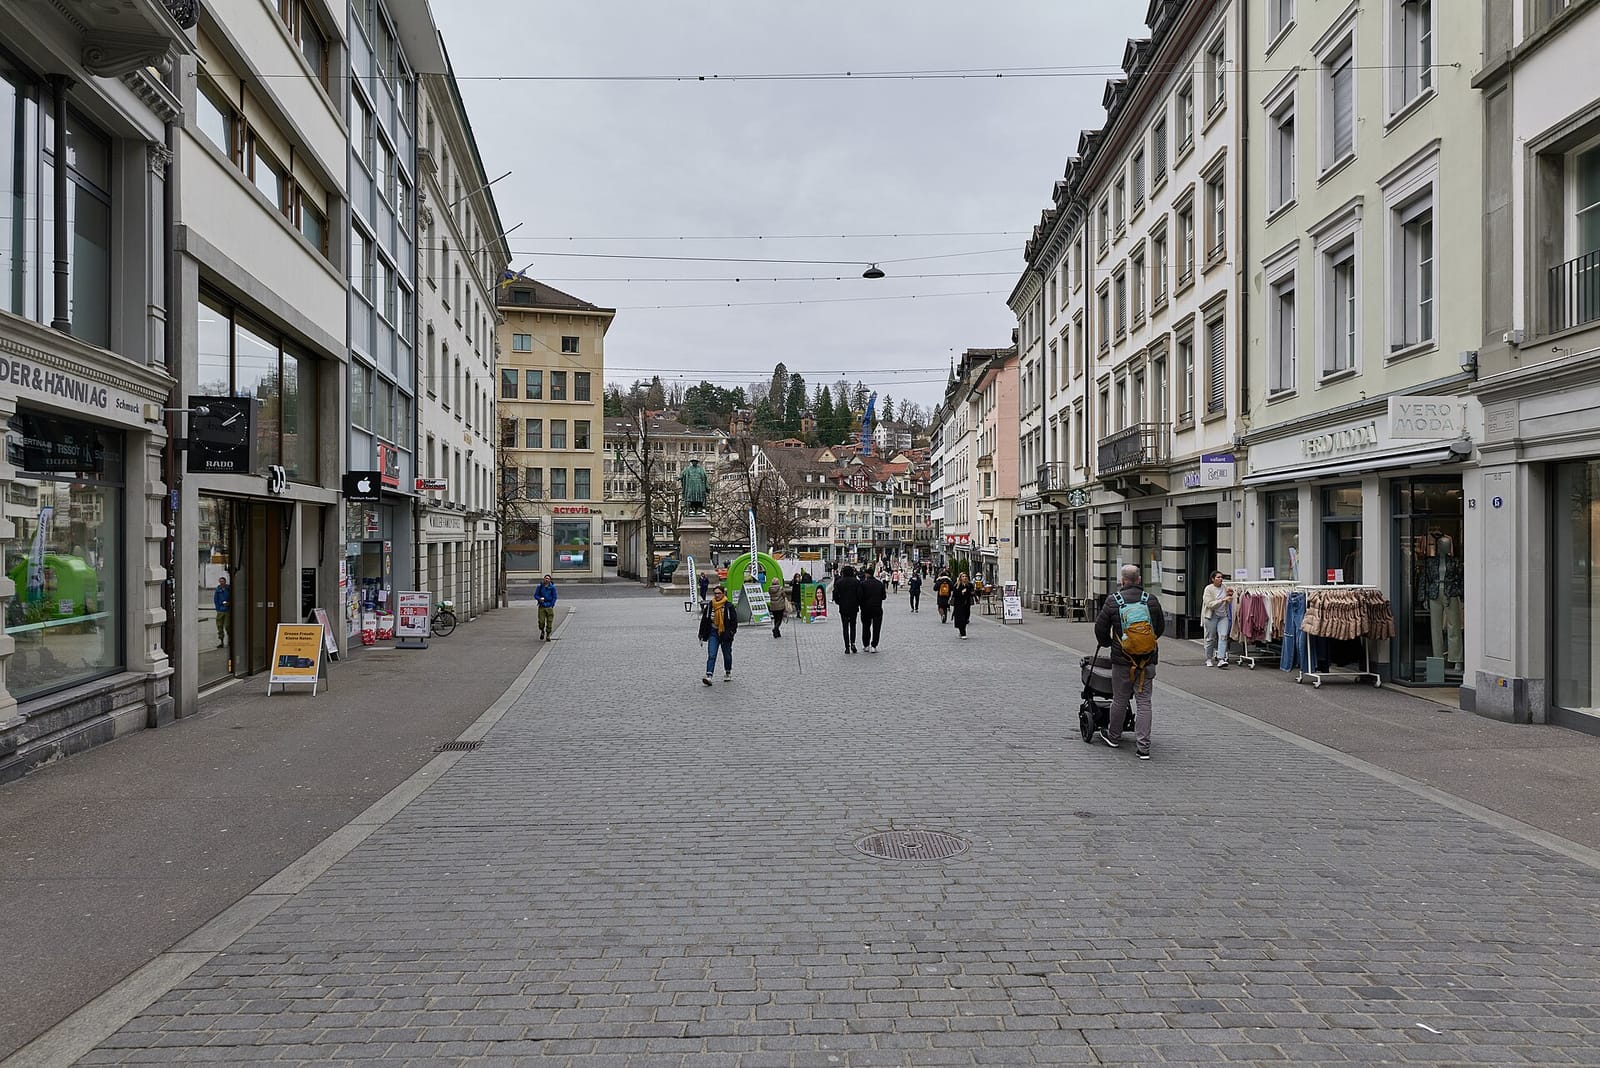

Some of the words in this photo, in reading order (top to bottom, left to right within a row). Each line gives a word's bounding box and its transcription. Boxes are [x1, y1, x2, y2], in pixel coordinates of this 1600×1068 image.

[115, 398, 140, 414] Schmuck
[1399, 404, 1451, 416] VERO
[1394, 418, 1454, 431] MODA
[57, 443, 80, 457] TISSOT
[205, 460, 234, 468] RADO
[553, 505, 589, 514] acrevis
[1468, 498, 1476, 509] 13
